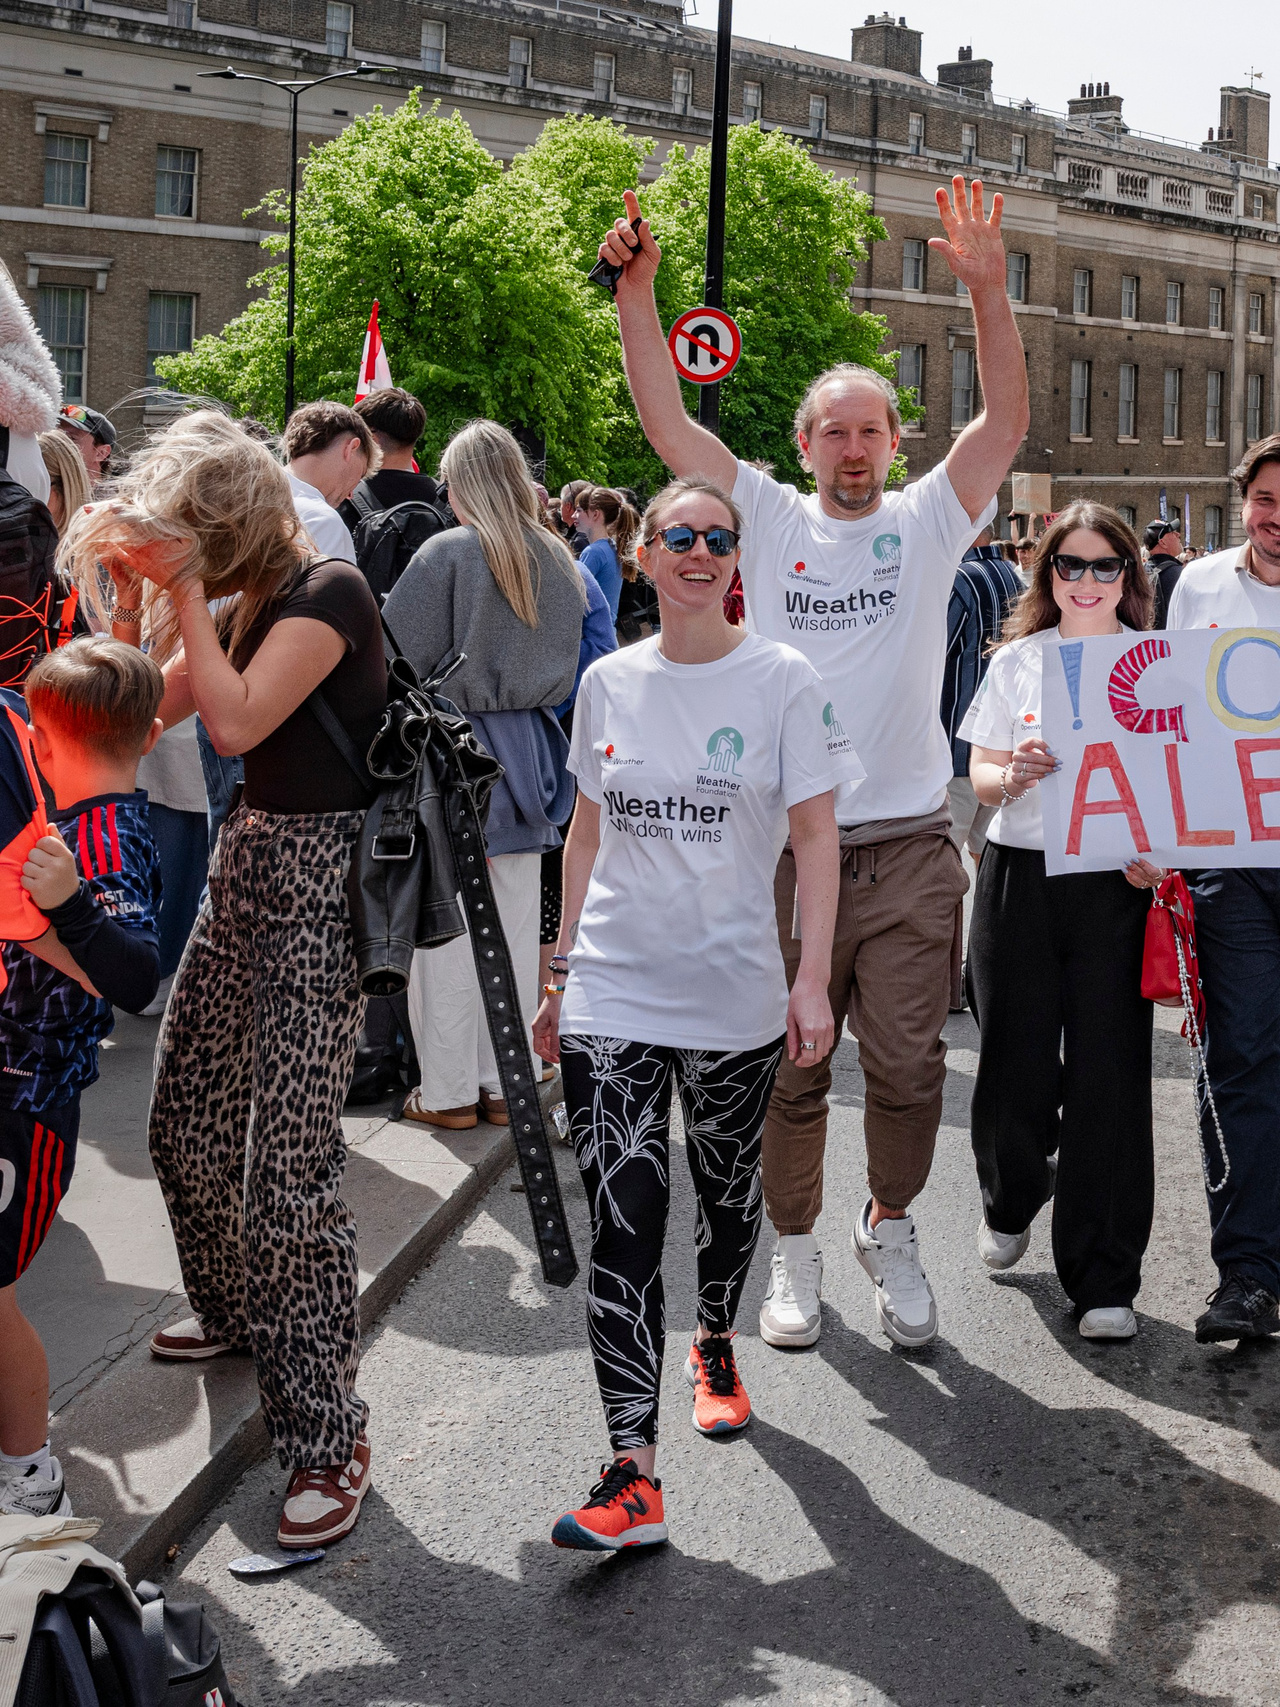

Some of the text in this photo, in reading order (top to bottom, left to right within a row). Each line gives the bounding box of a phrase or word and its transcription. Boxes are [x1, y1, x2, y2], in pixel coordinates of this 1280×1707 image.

[873, 564, 900, 576] Weath
[786, 571, 831, 587] OpenWeather
[874, 574, 899, 582] Foundat
[786, 588, 896, 614] Weathe
[788, 615, 857, 631] Wisdom
[827, 739, 852, 751] Weath
[828, 747, 854, 757] Foundat
[696, 775, 742, 791] Weather
[696, 786, 737, 798] Foundation
[603, 791, 730, 824] Weather
[610, 818, 722, 843] Wisdom wins
[104, 902, 144, 916] ANDA
